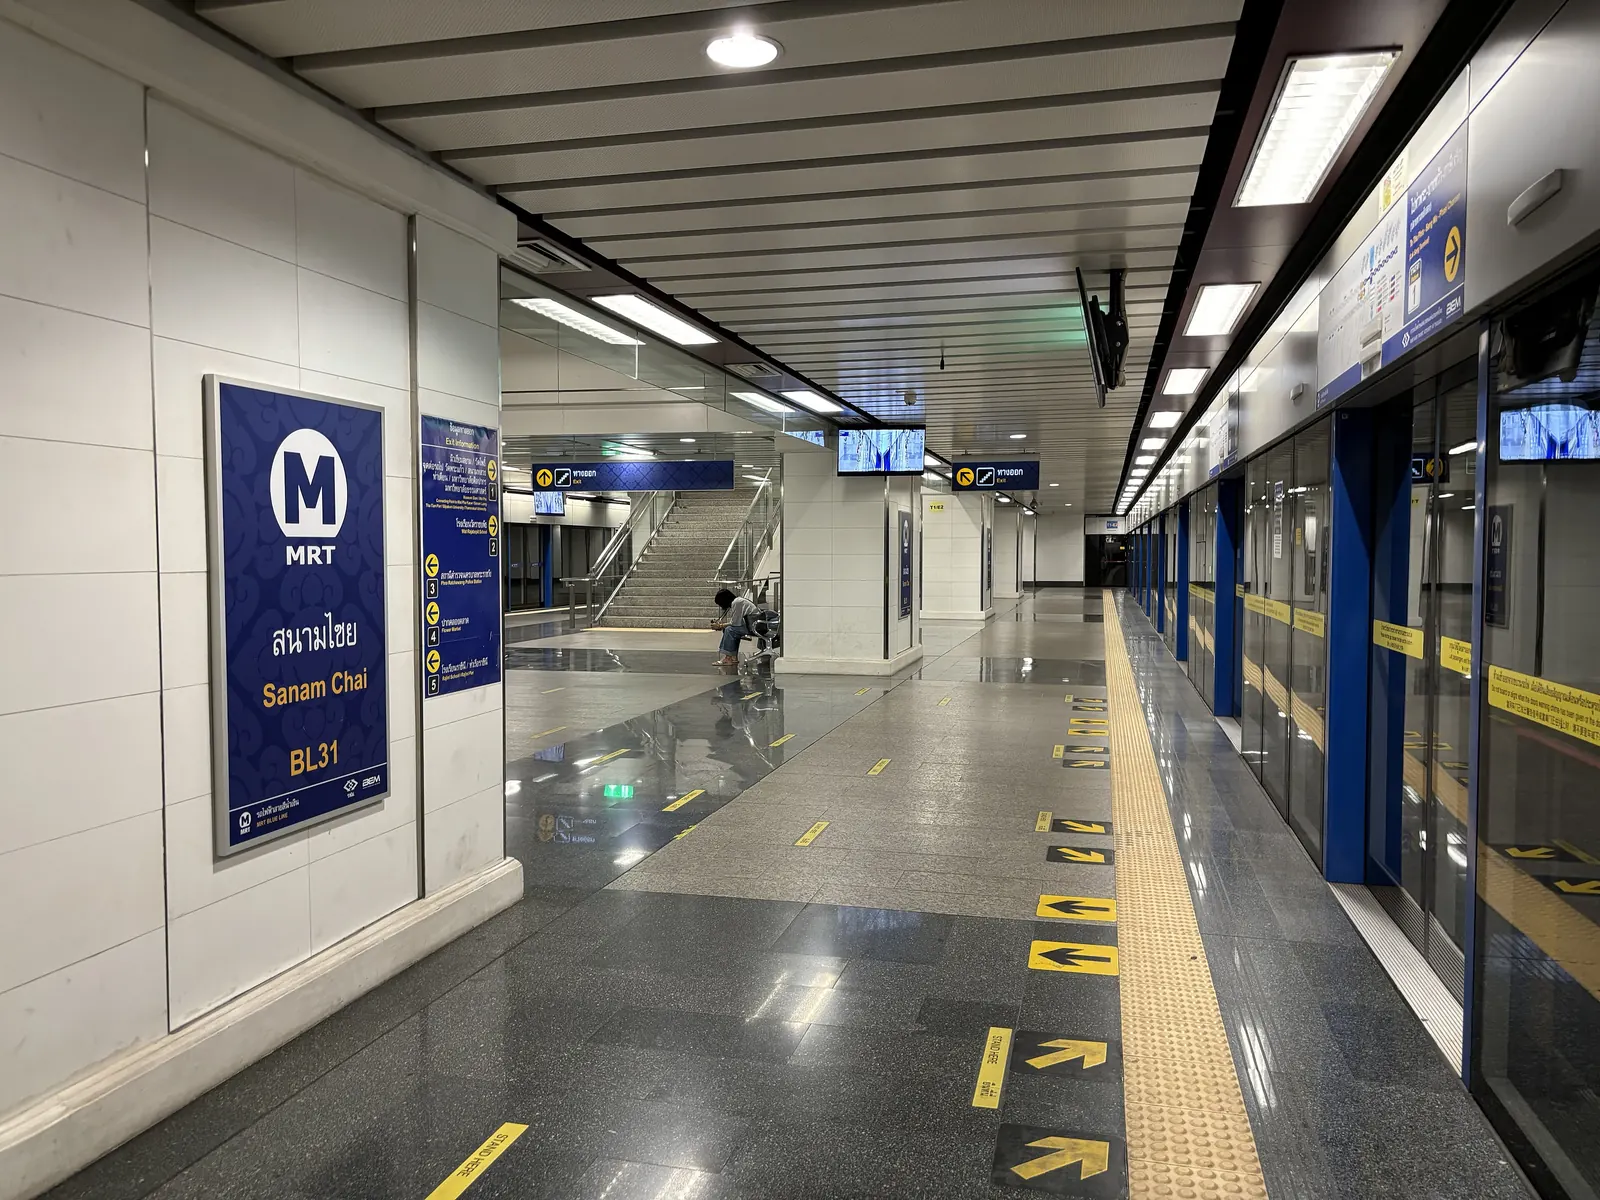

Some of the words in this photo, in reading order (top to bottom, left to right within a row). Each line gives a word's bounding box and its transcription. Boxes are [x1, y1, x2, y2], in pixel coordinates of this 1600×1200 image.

[446, 438, 455, 446] Exit
[456, 440, 480, 450] Information
[284, 451, 336, 525] M
[492, 542, 496, 552] 2
[286, 546, 336, 565] MRT
[430, 583, 435, 595] 3
[273, 612, 357, 656] สนามไชย
[431, 631, 436, 642] 4
[263, 680, 326, 708] Sanam
[331, 668, 368, 695] Chai
[431, 679, 437, 691] 5
[290, 740, 338, 777] BL31
[363, 775, 380, 787] BEM
[267, 816, 278, 824] BLUE
[240, 827, 250, 835] MRT
[990, 1035, 1003, 1051] STAND
[987, 1051, 1000, 1065] HERE
[479, 1133, 508, 1157] STAND
[456, 1157, 485, 1178] HERE
